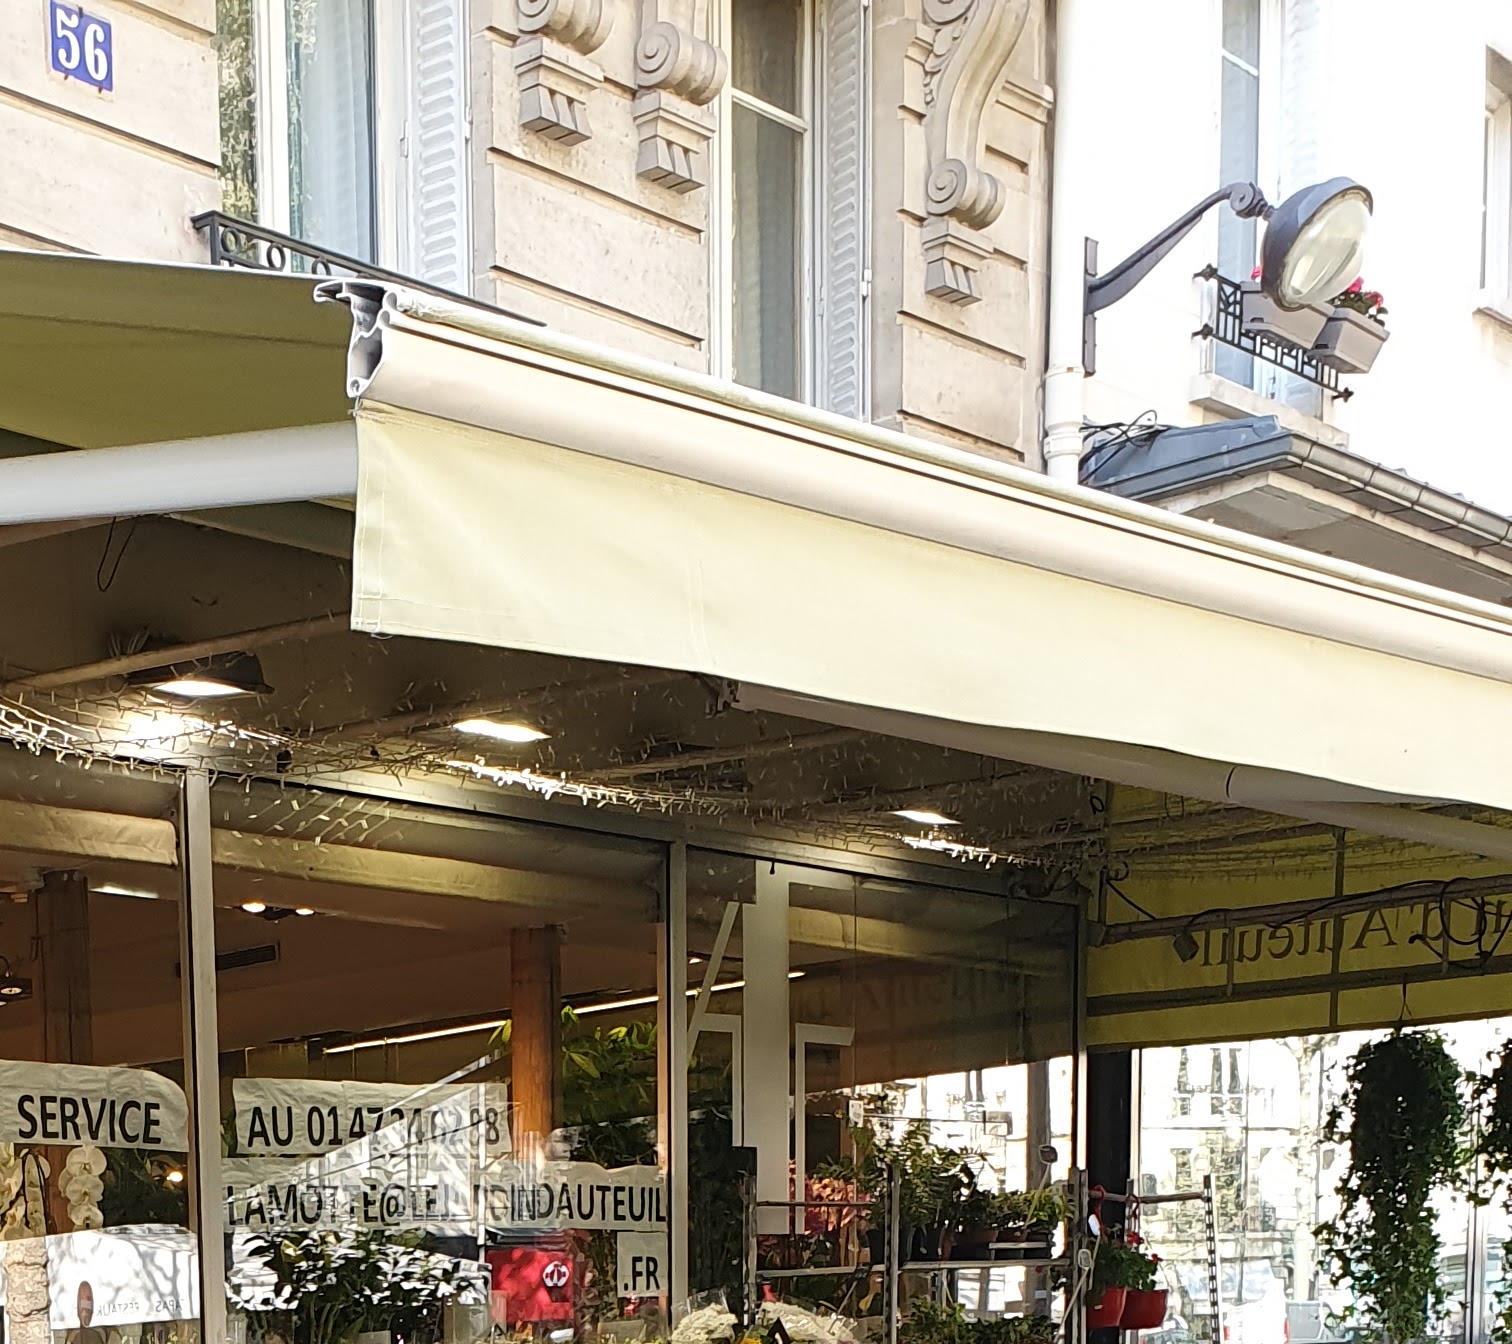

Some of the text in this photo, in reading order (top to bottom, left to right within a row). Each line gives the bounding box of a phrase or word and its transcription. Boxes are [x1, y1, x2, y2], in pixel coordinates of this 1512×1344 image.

[55, 8, 108, 81] 56
[17, 1094, 162, 1145] SERVICE
[247, 1106, 293, 1146] AU
[623, 1255, 659, 1292] .FR
